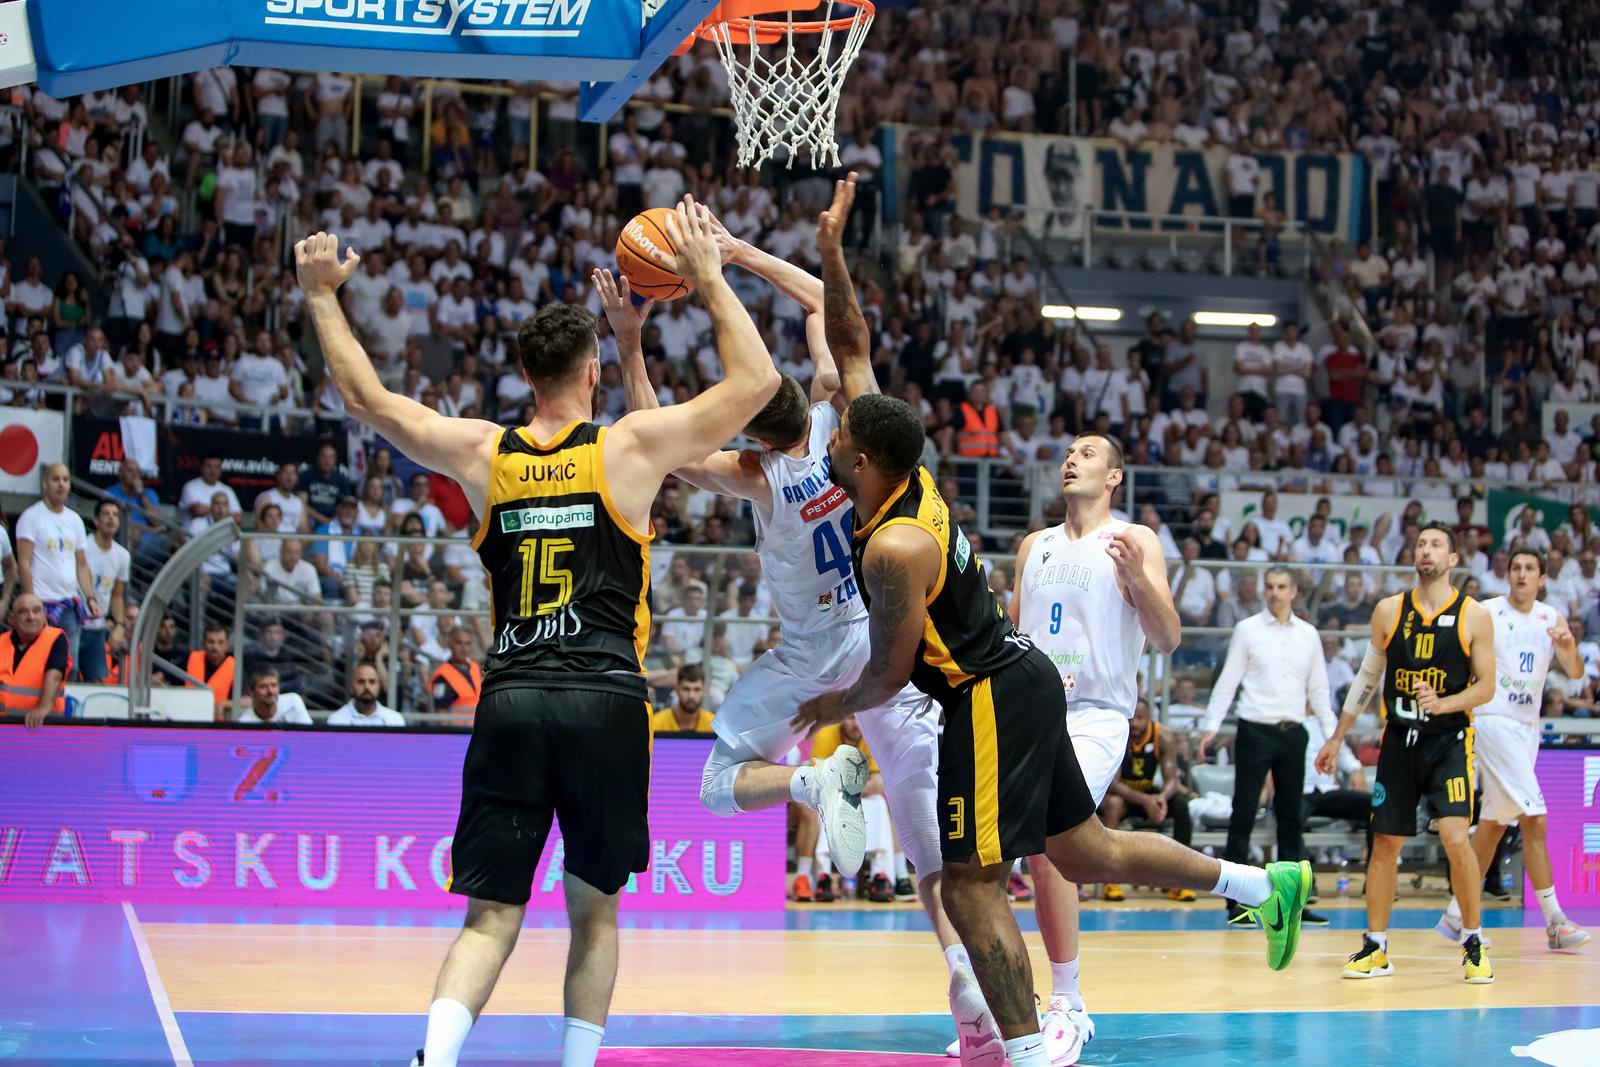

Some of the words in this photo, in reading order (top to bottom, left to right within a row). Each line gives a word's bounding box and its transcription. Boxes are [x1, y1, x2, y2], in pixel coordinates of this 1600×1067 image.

[519, 458, 577, 482] JUKIĆ
[523, 511, 593, 527] Groupama
[518, 538, 575, 617] 15
[1031, 563, 1092, 593] ZADAR
[1049, 602, 1063, 635] 9
[1414, 633, 1434, 659] 10
[1519, 651, 1534, 673] 20
[1445, 777, 1466, 804] 10
[948, 796, 965, 840] 3
